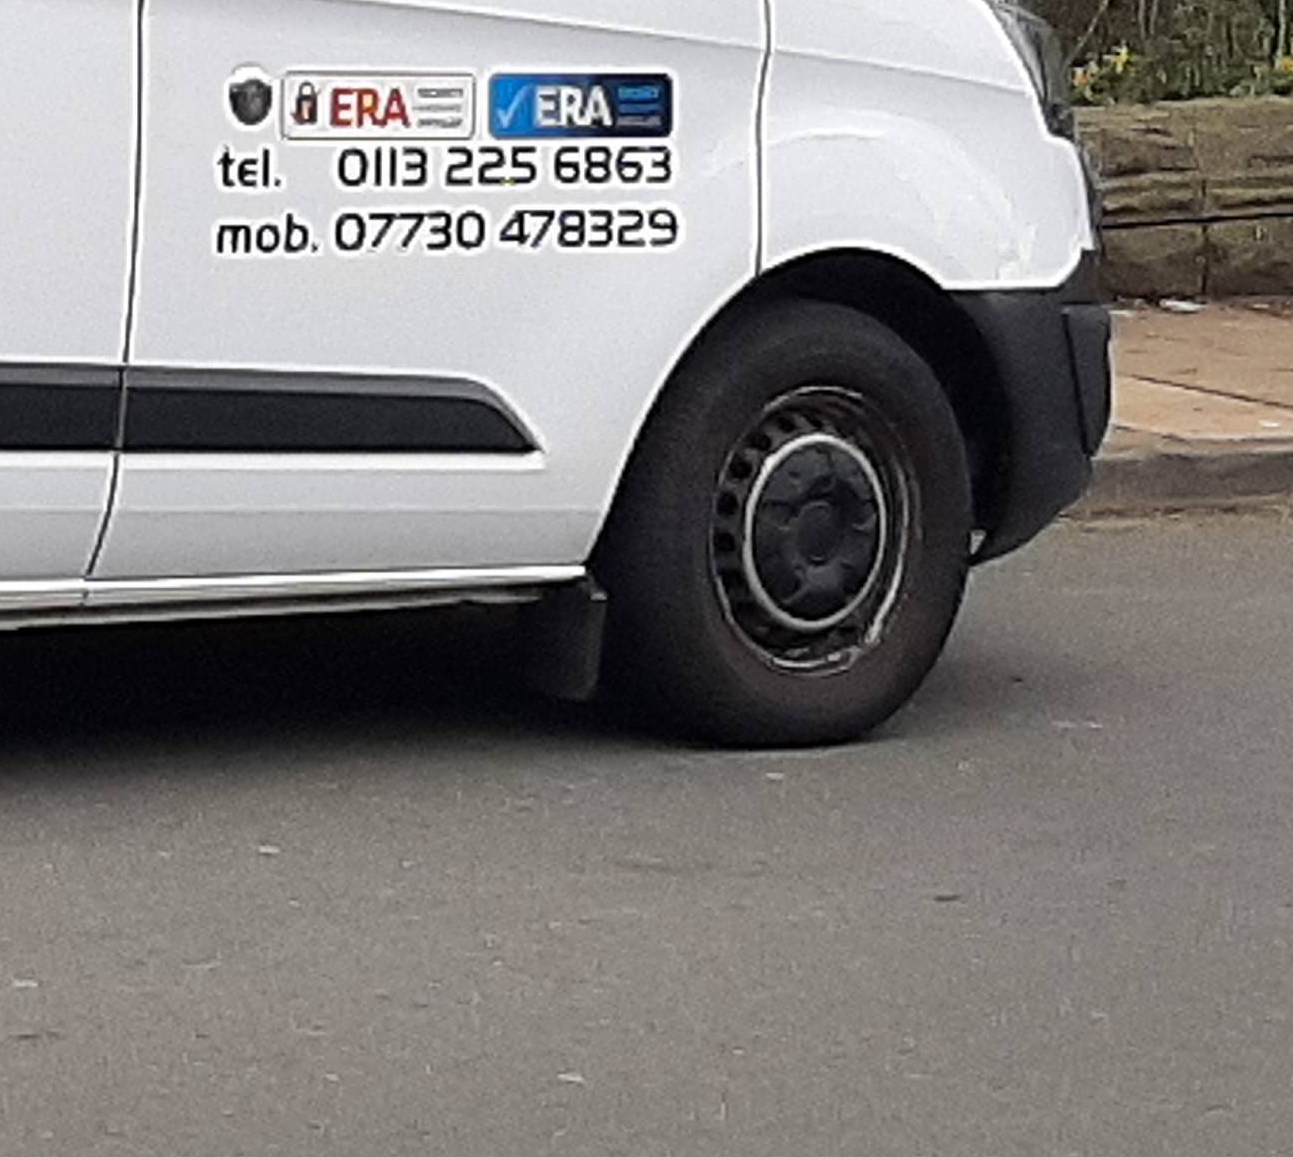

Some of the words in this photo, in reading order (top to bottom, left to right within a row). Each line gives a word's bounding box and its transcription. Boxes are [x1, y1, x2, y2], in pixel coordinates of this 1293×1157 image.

[329, 86, 411, 129] ERA
[535, 85, 613, 127] ERA
[217, 146, 282, 187] tel.
[337, 147, 428, 187] 0113
[444, 147, 537, 187] 225
[553, 146, 672, 184] 6863
[216, 213, 319, 254] mob.
[334, 211, 486, 250] 07730
[499, 210, 679, 248] 478329
